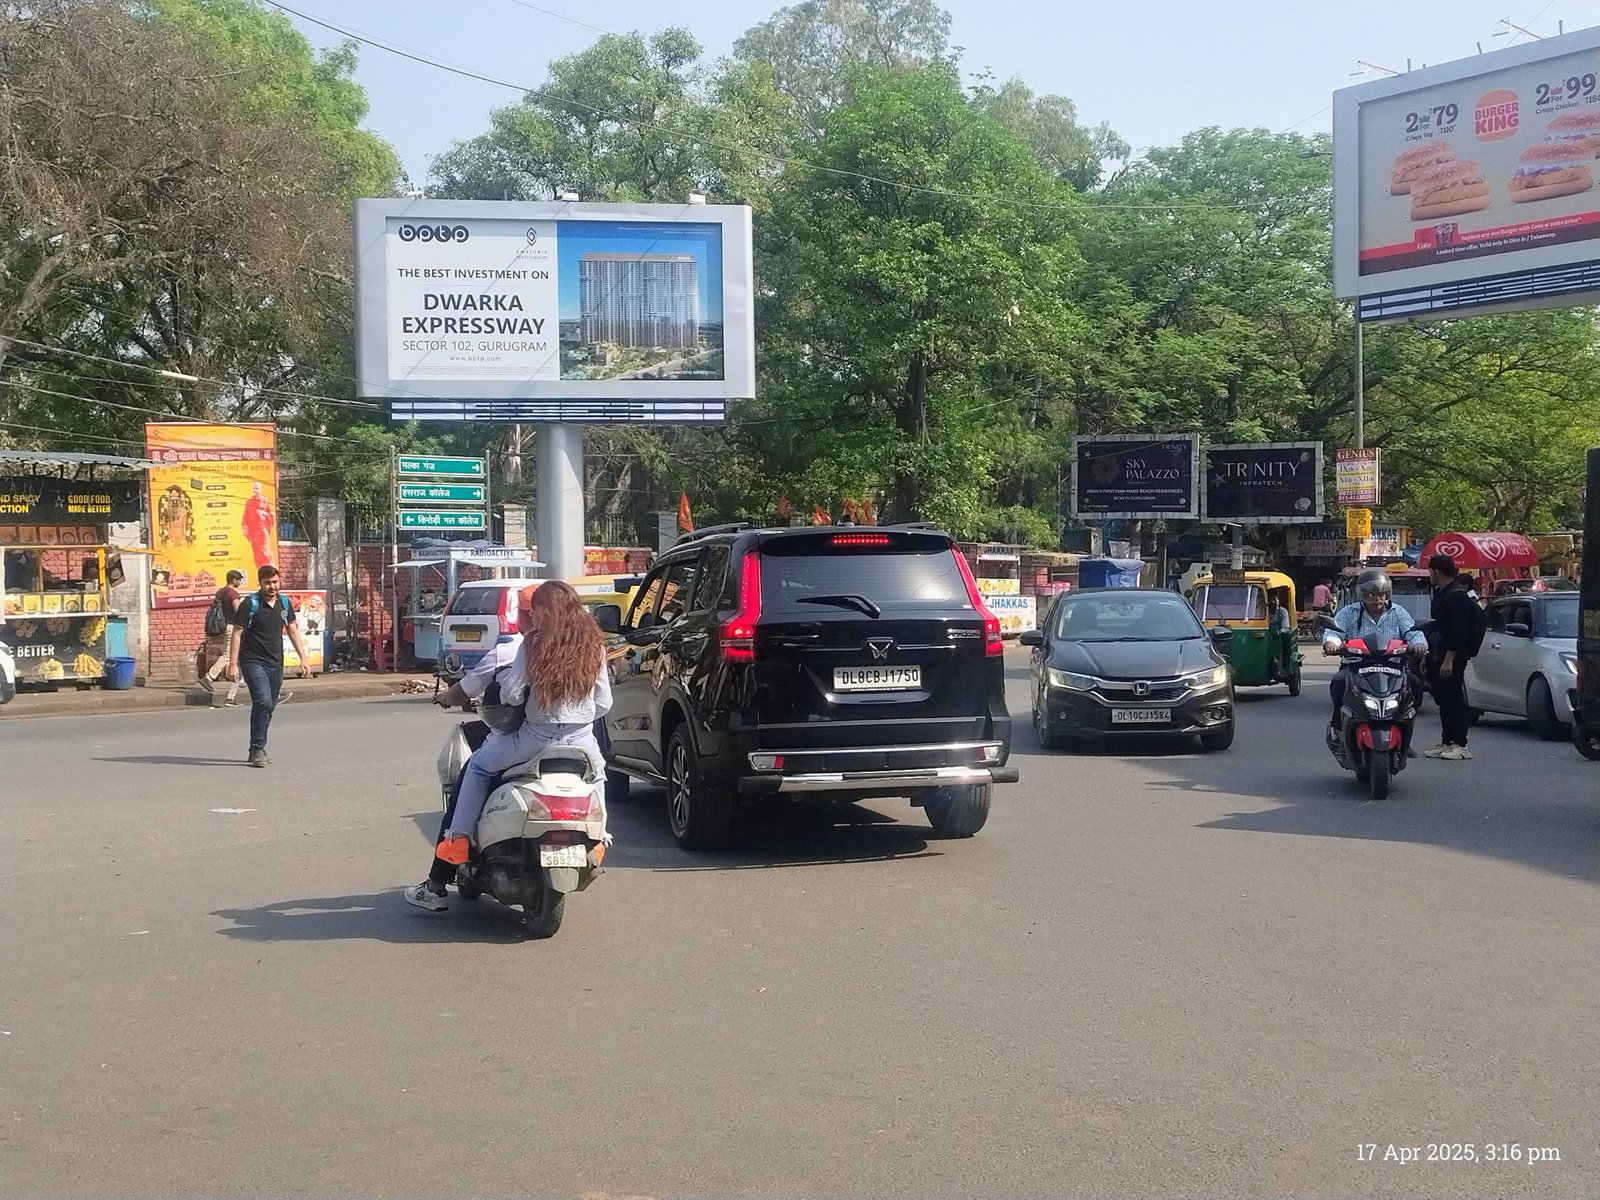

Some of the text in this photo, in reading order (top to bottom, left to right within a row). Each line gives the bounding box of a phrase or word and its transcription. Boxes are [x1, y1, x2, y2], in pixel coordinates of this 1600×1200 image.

[1536, 83, 1550, 105] 2
[1475, 101, 1519, 120] BURGER
[1536, 101, 1579, 114] Crispy Chicken
[1405, 112, 1419, 133] 2
[1475, 113, 1519, 135] KING
[1405, 134, 1422, 142] Crispy
[399, 224, 470, 243] bptp
[1417, 242, 1432, 250] Coke
[1436, 247, 1455, 255] Limited
[398, 268, 549, 279] THE BEST INVESTMENT ON
[424, 294, 523, 311] DWARKA
[402, 317, 546, 335] EXPRESSWAY
[403, 340, 547, 352] SECTOR 102, GURUGRAM
[1337, 448, 1375, 459] GENIUS
[422, 460, 435, 470] गंज
[1126, 459, 1148, 468] SKY
[1222, 461, 1301, 477] TRNITY
[1126, 469, 1180, 479] PALAZZO
[402, 486, 426, 497] हंसराज
[13, 494, 40, 503] SPICY
[68, 495, 110, 504] GOOD FOOD
[0, 504, 29, 513] CTION
[68, 504, 111, 513] MADE BETTER
[443, 517, 456, 525] मल
[1371, 528, 1397, 540] AKKAS
[419, 549, 450, 557] RADIOACTIVE
[470, 549, 514, 557] RADIOACTIVE
[984, 546, 1014, 554] JHAKKAS
[990, 598, 1028, 609] JHAKKAS
[17, 644, 55, 658] BETTER
[842, 669, 919, 685] DL8CBJ1750
